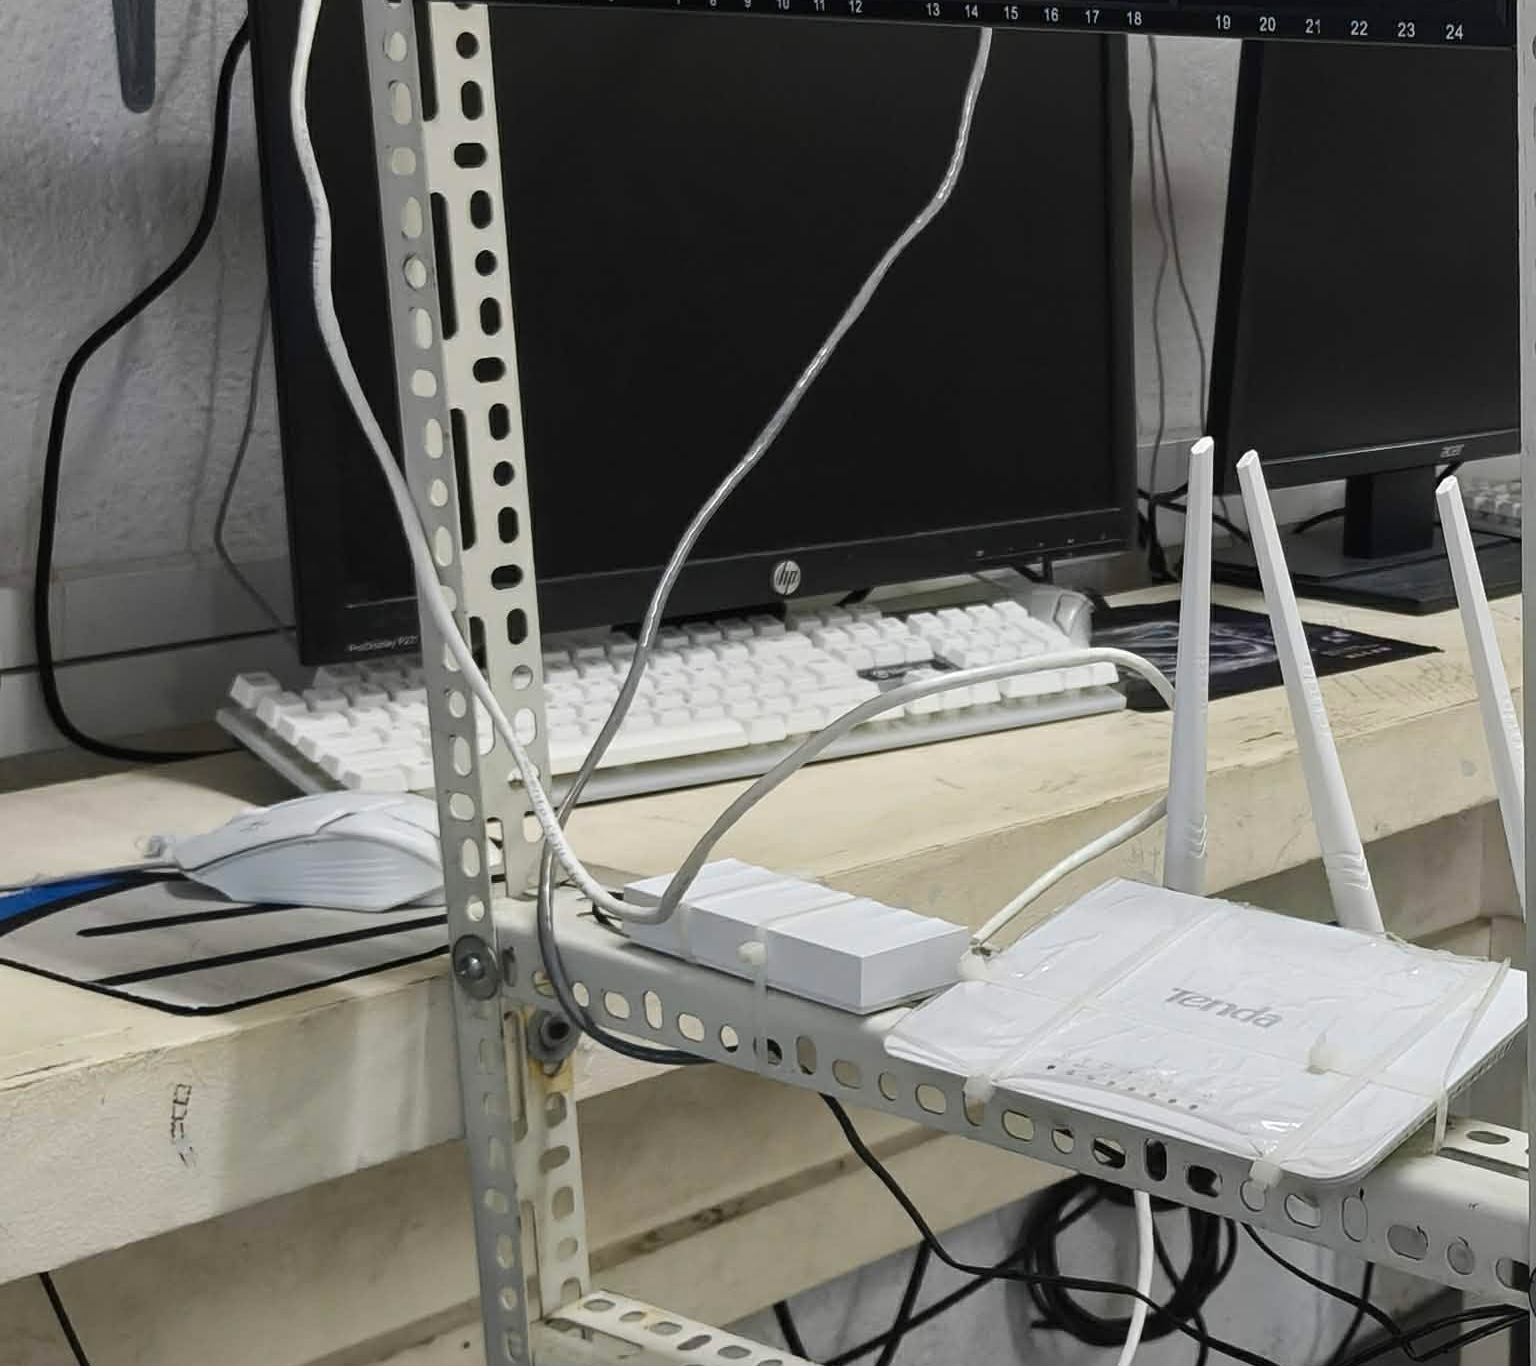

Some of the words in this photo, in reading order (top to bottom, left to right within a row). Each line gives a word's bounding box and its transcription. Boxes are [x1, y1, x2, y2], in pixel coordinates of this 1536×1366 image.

[849, 0, 863, 14] 12
[926, 2, 941, 17] 13
[964, 4, 979, 18] 14
[1004, 5, 1019, 20] 15
[1044, 7, 1059, 22] 16
[1085, 9, 1100, 24] 17
[1126, 10, 1143, 26] 18
[1215, 14, 1231, 30] 19
[1259, 16, 1277, 33] 20
[1305, 18, 1321, 34] 21
[1350, 19, 1369, 36] 22
[1397, 21, 1416, 38] 23
[1445, 23, 1464, 40] 24
[774, 560, 801, 596] hp
[1164, 986, 1283, 1028] Tenda
